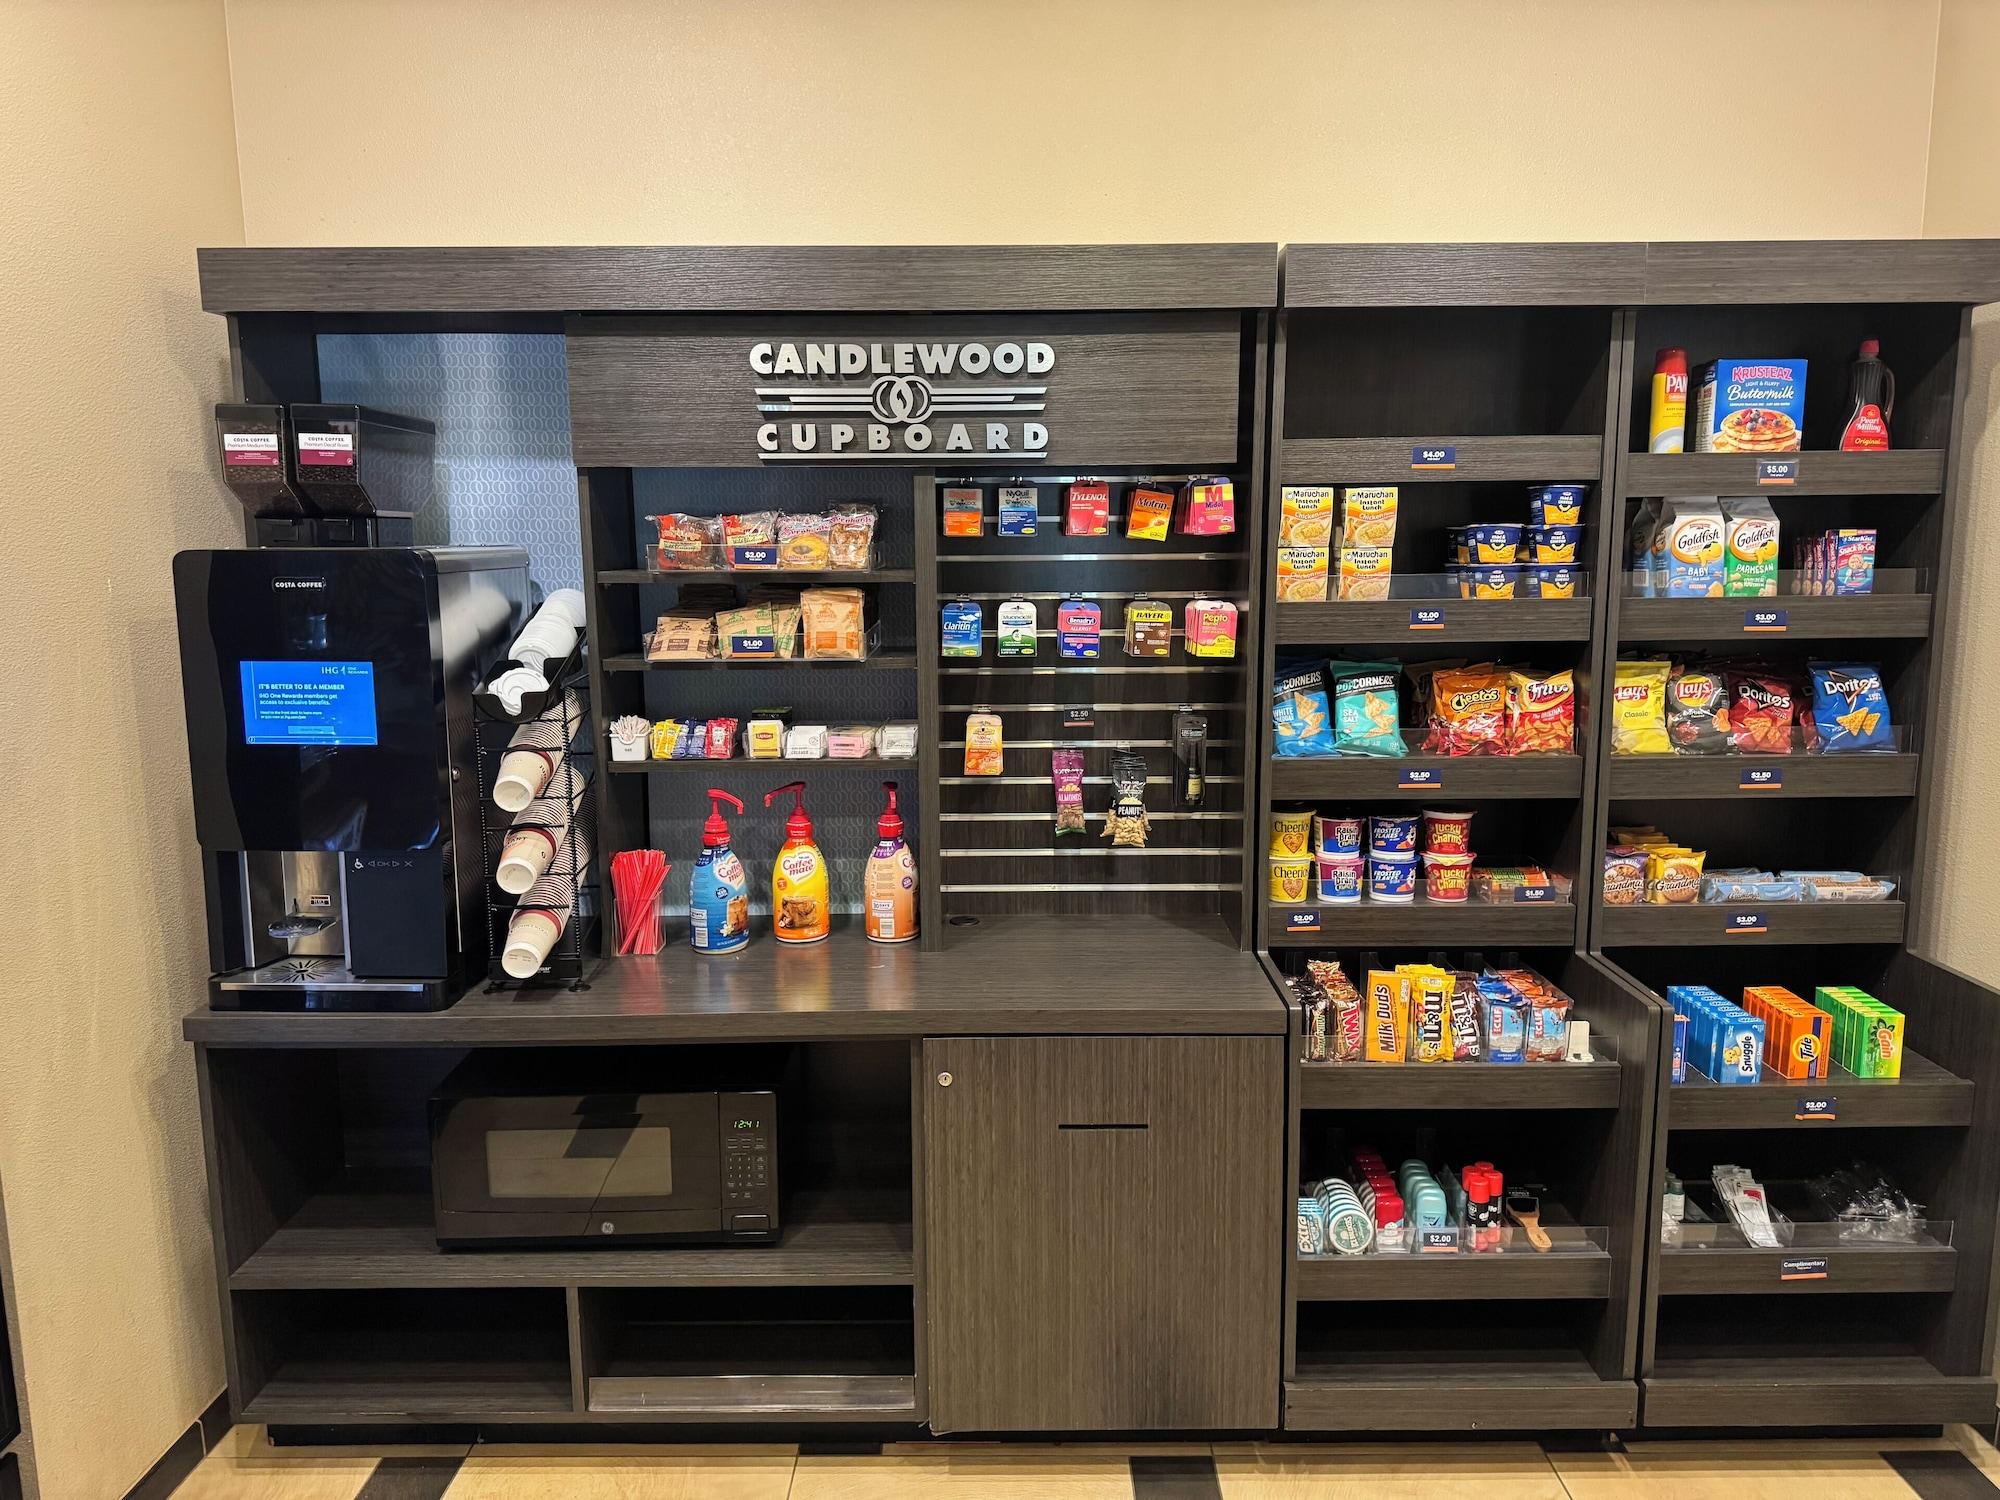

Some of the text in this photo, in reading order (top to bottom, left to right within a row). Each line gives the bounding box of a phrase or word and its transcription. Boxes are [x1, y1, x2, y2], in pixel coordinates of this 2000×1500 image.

[749, 342, 1056, 375] CANDLEWOOD
[1732, 366, 1793, 382] KRUSTEAZ
[1727, 385, 1794, 401] Buttermilk
[1856, 423, 1881, 432] Milling
[756, 423, 1049, 452] CUPBOARD
[1855, 438, 1880, 446] Original
[1422, 450, 1445, 458] $4.00
[1767, 465, 1788, 473] $5.00
[1006, 490, 1030, 498] NyQuil
[1071, 493, 1107, 501] TYLENOL
[1293, 490, 1329, 498] Maruchan
[1356, 491, 1394, 499] Maruchan
[1136, 497, 1168, 510] Motrin
[1678, 527, 1720, 549] Goldfish
[1737, 526, 1775, 547] Goldfish
[745, 551, 767, 559] $2.00
[1687, 567, 1709, 576] BABY
[1735, 563, 1774, 574] PARMESAN
[275, 581, 323, 589] COSTA COFFEE
[1203, 613, 1228, 624] Pepto
[1418, 611, 1439, 619] $2.00
[943, 620, 971, 631] Claritin
[1069, 617, 1095, 625] Benadryl
[742, 640, 763, 648] $1.00
[321, 666, 339, 674] IHG
[1336, 675, 1394, 693] POPCORNERS
[1824, 676, 1880, 695] Doritos
[1614, 685, 1648, 700] Lay's
[1680, 682, 1710, 698] Lay's
[1451, 688, 1499, 711] Cheetos
[1738, 685, 1790, 708] Doritos
[1273, 706, 1294, 718] WHITE
[1343, 708, 1358, 716] SEA
[1343, 715, 1359, 723] SALT
[1058, 792, 1082, 802] ALMONDS
[1336, 826, 1358, 835] Raisin
[1339, 833, 1356, 841] Bran
[1432, 833, 1462, 844] Charms
[782, 859, 813, 870] Coffee
[789, 865, 814, 877] mate
[1332, 869, 1356, 878] Raisin
[1336, 877, 1353, 885] Bran
[1437, 878, 1466, 890] Charms
[1373, 984, 1396, 1053] Milk Duds
[1422, 990, 1444, 1055] m&m's
[1341, 1003, 1361, 1053] TWIX
[1451, 992, 1480, 1057] m&m's
[1800, 1037, 1814, 1060] Tide
[1877, 1029, 1893, 1059] Gain
[1742, 1035, 1753, 1072] Snuggle
[1806, 1101, 1827, 1109] $2.00
[733, 1120, 760, 1129] 12:41
[1430, 1234, 1452, 1243] $2.00
